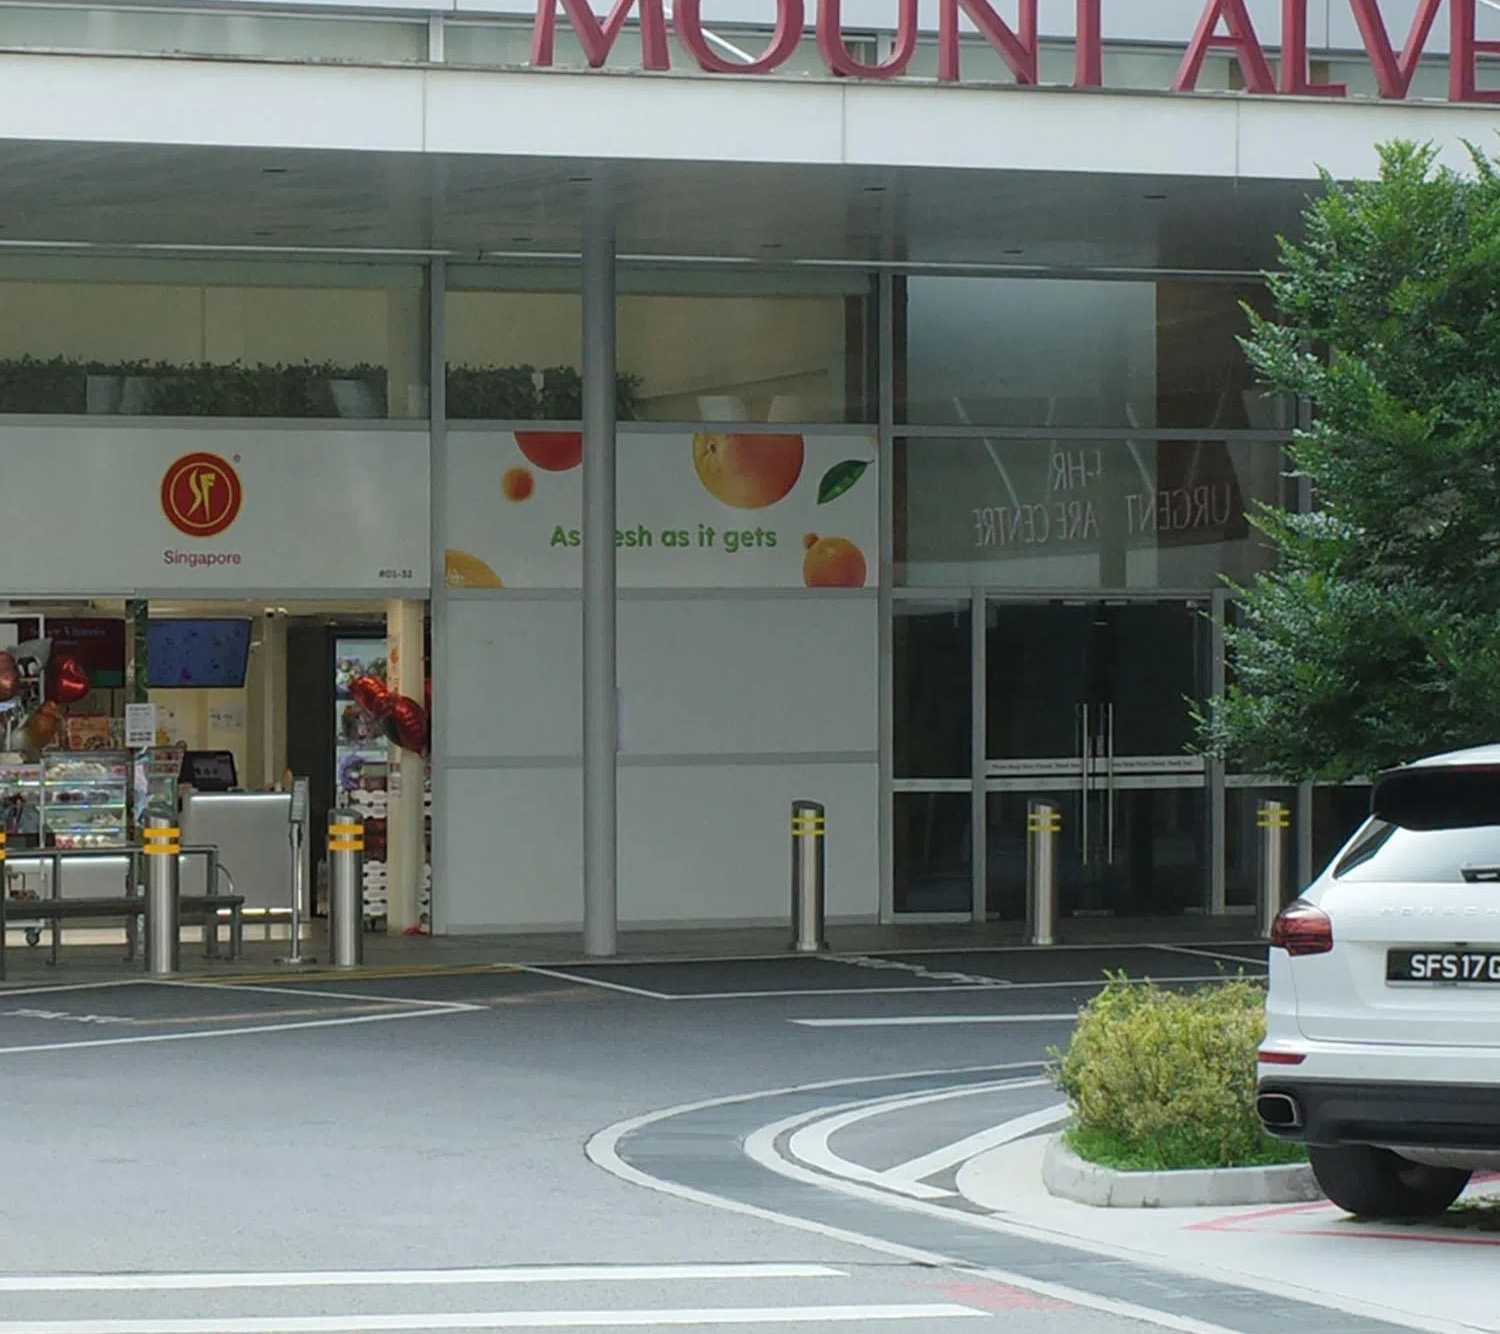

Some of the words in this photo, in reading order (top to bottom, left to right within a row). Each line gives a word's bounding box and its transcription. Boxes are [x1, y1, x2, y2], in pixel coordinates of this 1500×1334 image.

[549, 524, 582, 547] As
[613, 524, 653, 548] esh
[660, 529, 691, 548] as
[698, 523, 716, 548] it
[722, 526, 778, 554] gets
[162, 549, 242, 568] Singapore
